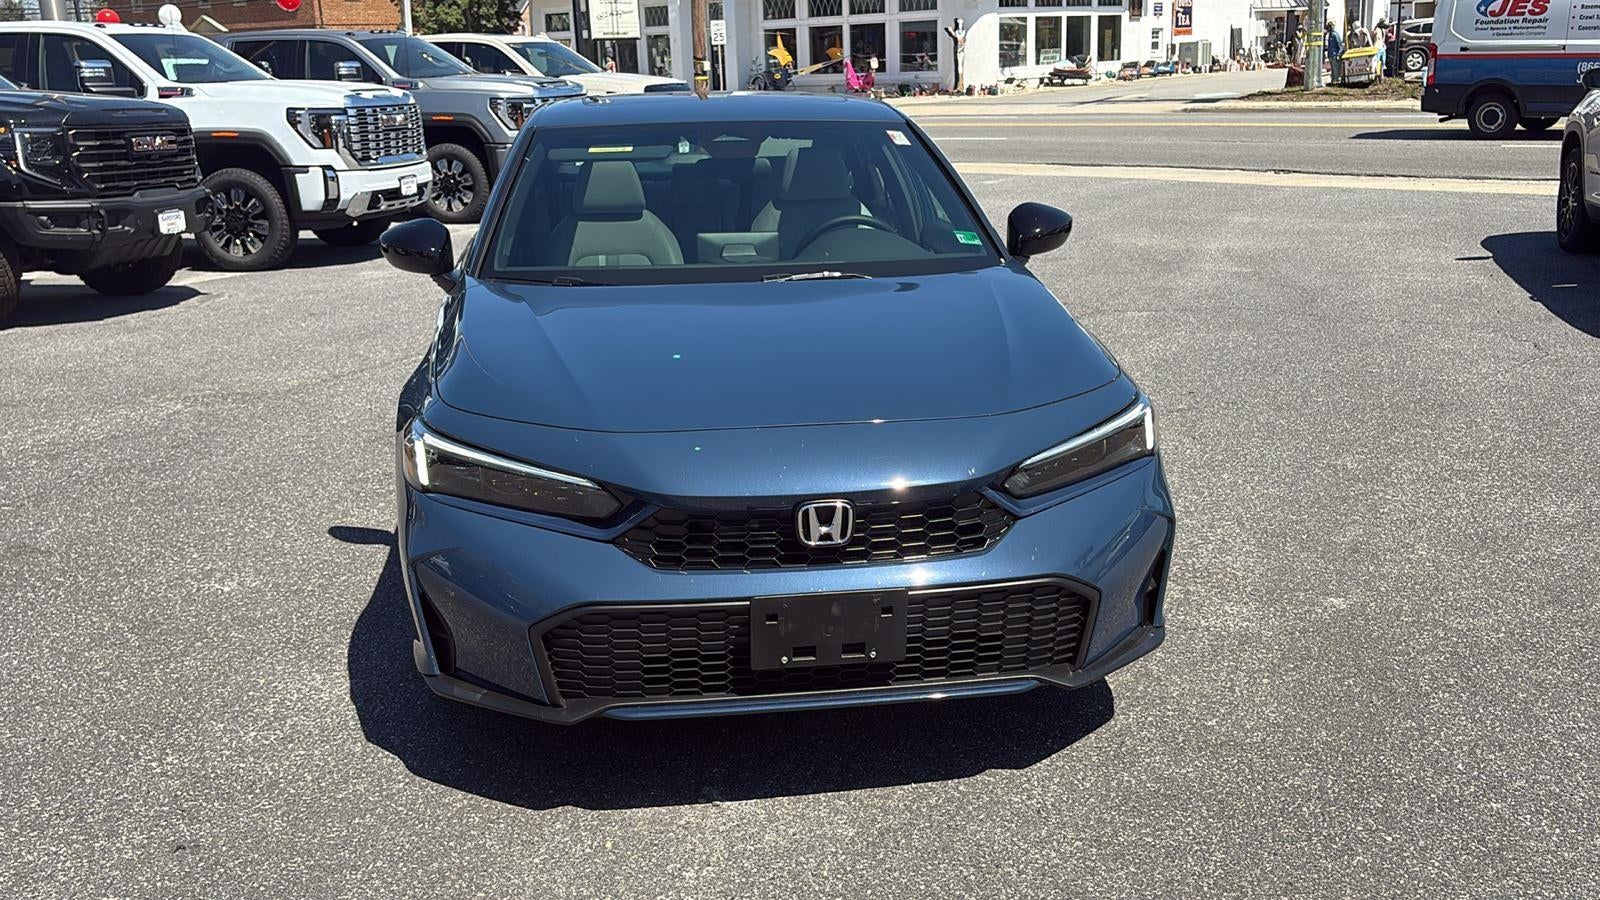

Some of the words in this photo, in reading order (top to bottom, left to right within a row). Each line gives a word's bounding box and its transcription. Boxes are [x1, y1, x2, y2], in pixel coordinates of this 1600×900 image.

[1489, 0, 1550, 17] JES
[1177, 13, 1191, 26] TEA
[713, 32, 724, 41] 25
[132, 136, 178, 152] GMC
